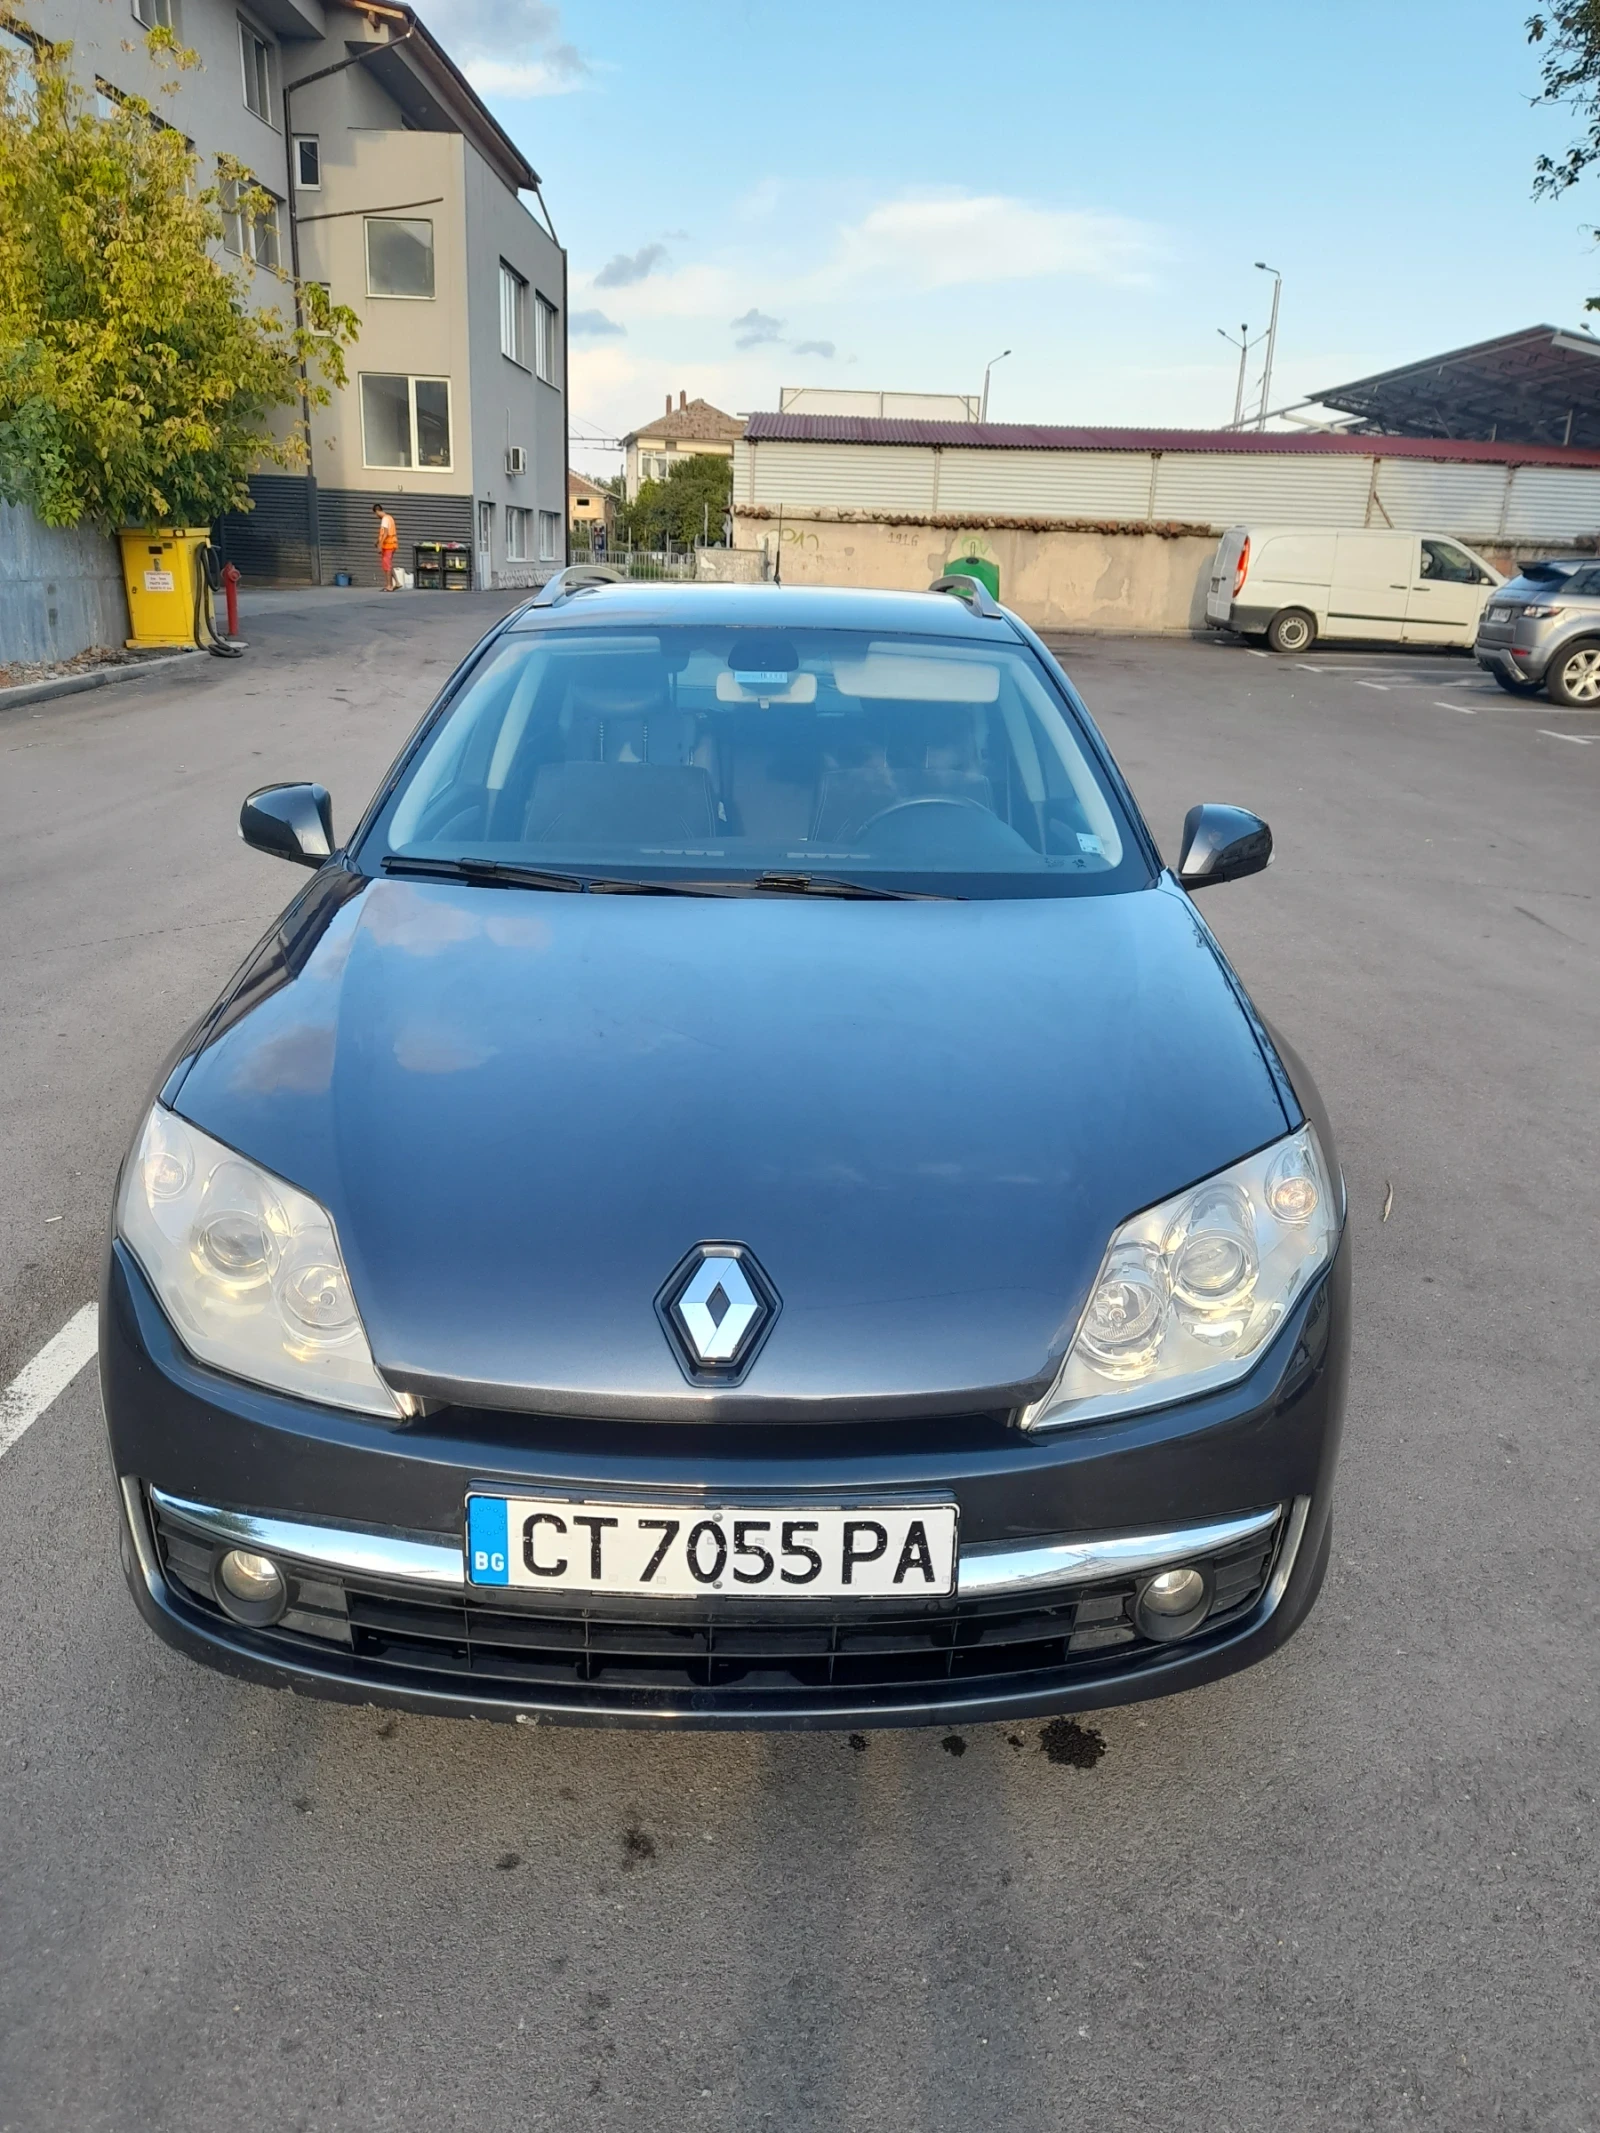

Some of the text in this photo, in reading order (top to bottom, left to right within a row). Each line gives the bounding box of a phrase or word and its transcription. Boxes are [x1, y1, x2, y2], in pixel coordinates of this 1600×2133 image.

[474, 1551, 505, 1572] BG
[522, 1513, 936, 1585] CT 7055 PA
